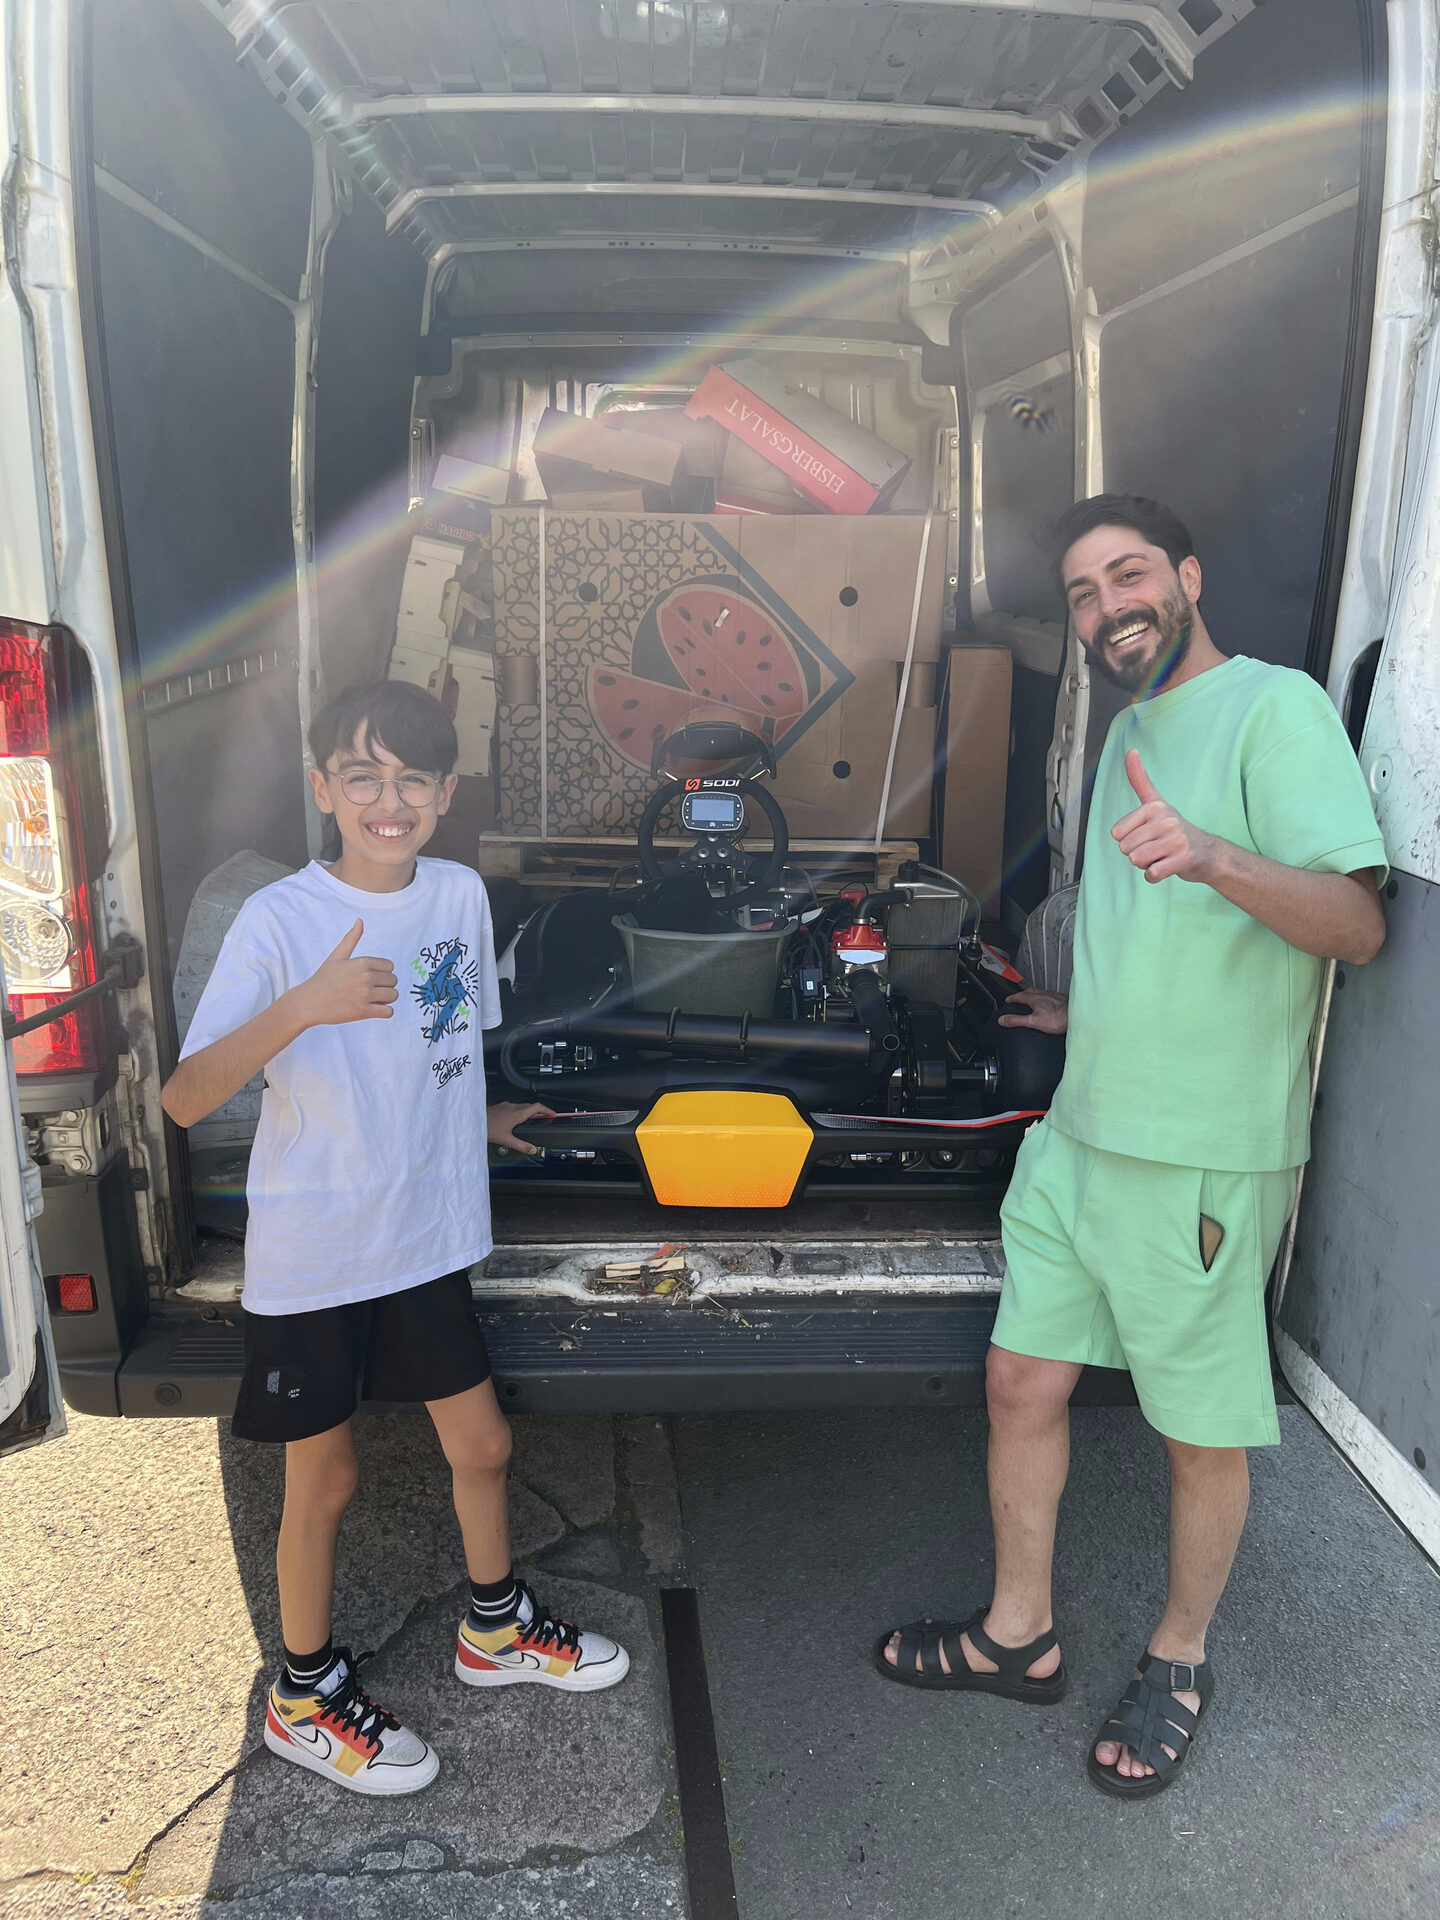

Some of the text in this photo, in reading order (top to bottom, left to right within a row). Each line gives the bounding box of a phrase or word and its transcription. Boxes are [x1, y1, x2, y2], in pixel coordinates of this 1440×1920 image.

[724, 399, 846, 495] EISBERGSALAT
[439, 523, 475, 542] HARIBO
[702, 779, 741, 788] SODI
[420, 937, 468, 964] SUPER
